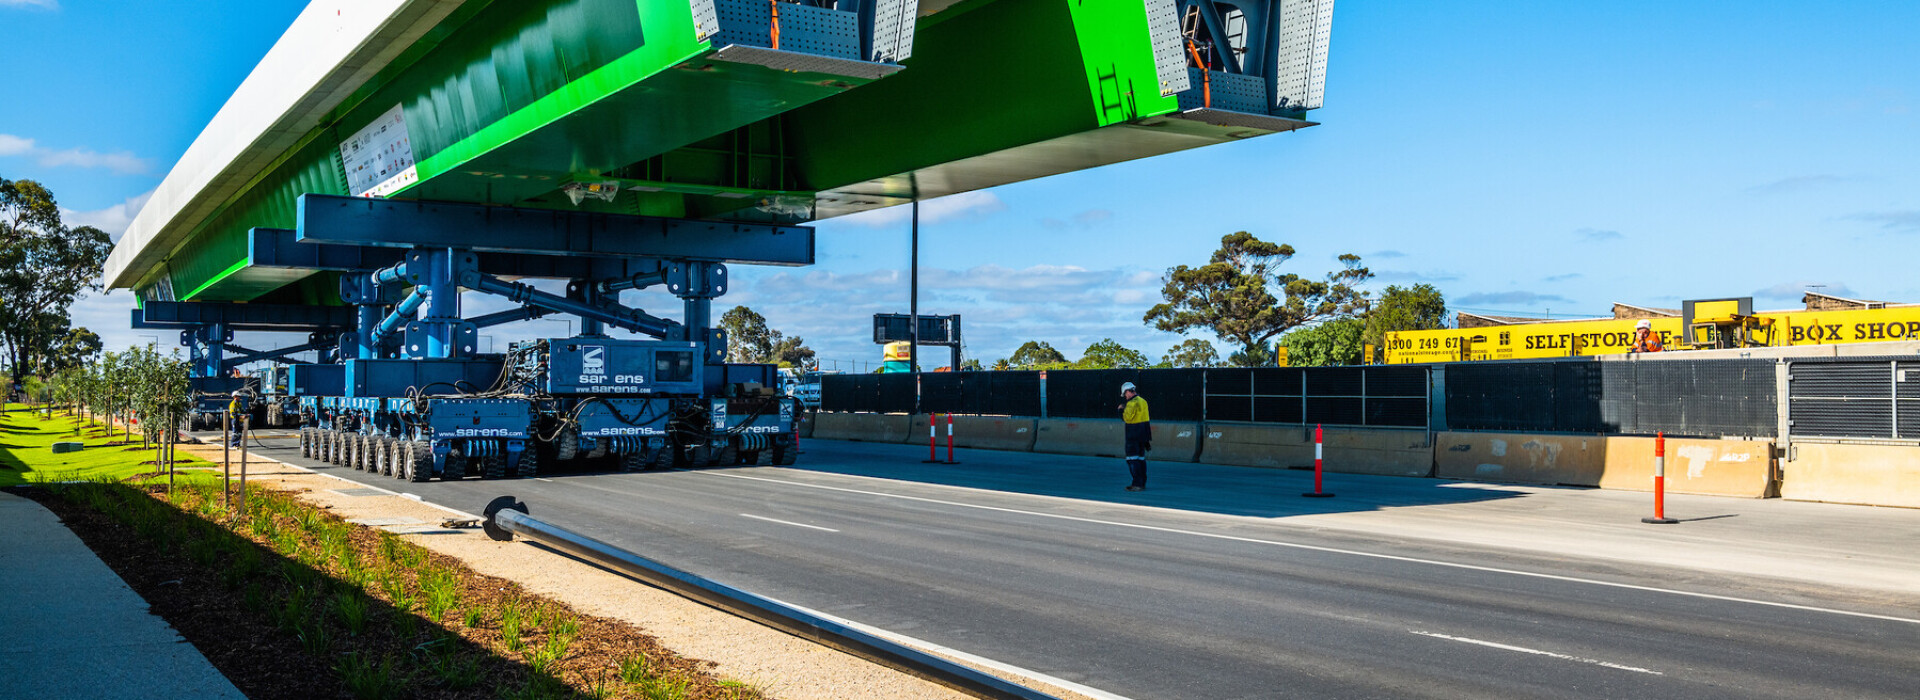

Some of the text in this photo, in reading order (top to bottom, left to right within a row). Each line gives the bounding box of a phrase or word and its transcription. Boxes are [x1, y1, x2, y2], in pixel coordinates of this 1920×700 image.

[1791, 321, 1920, 341] BOX SHOP
[1387, 337, 1461, 350] 1300 749 67
[1526, 330, 1672, 350] SELF STORE
[575, 385, 652, 394] www.sarens.com
[438, 427, 523, 437] www.sarens.com
[581, 427, 666, 436] www.sarens.com
